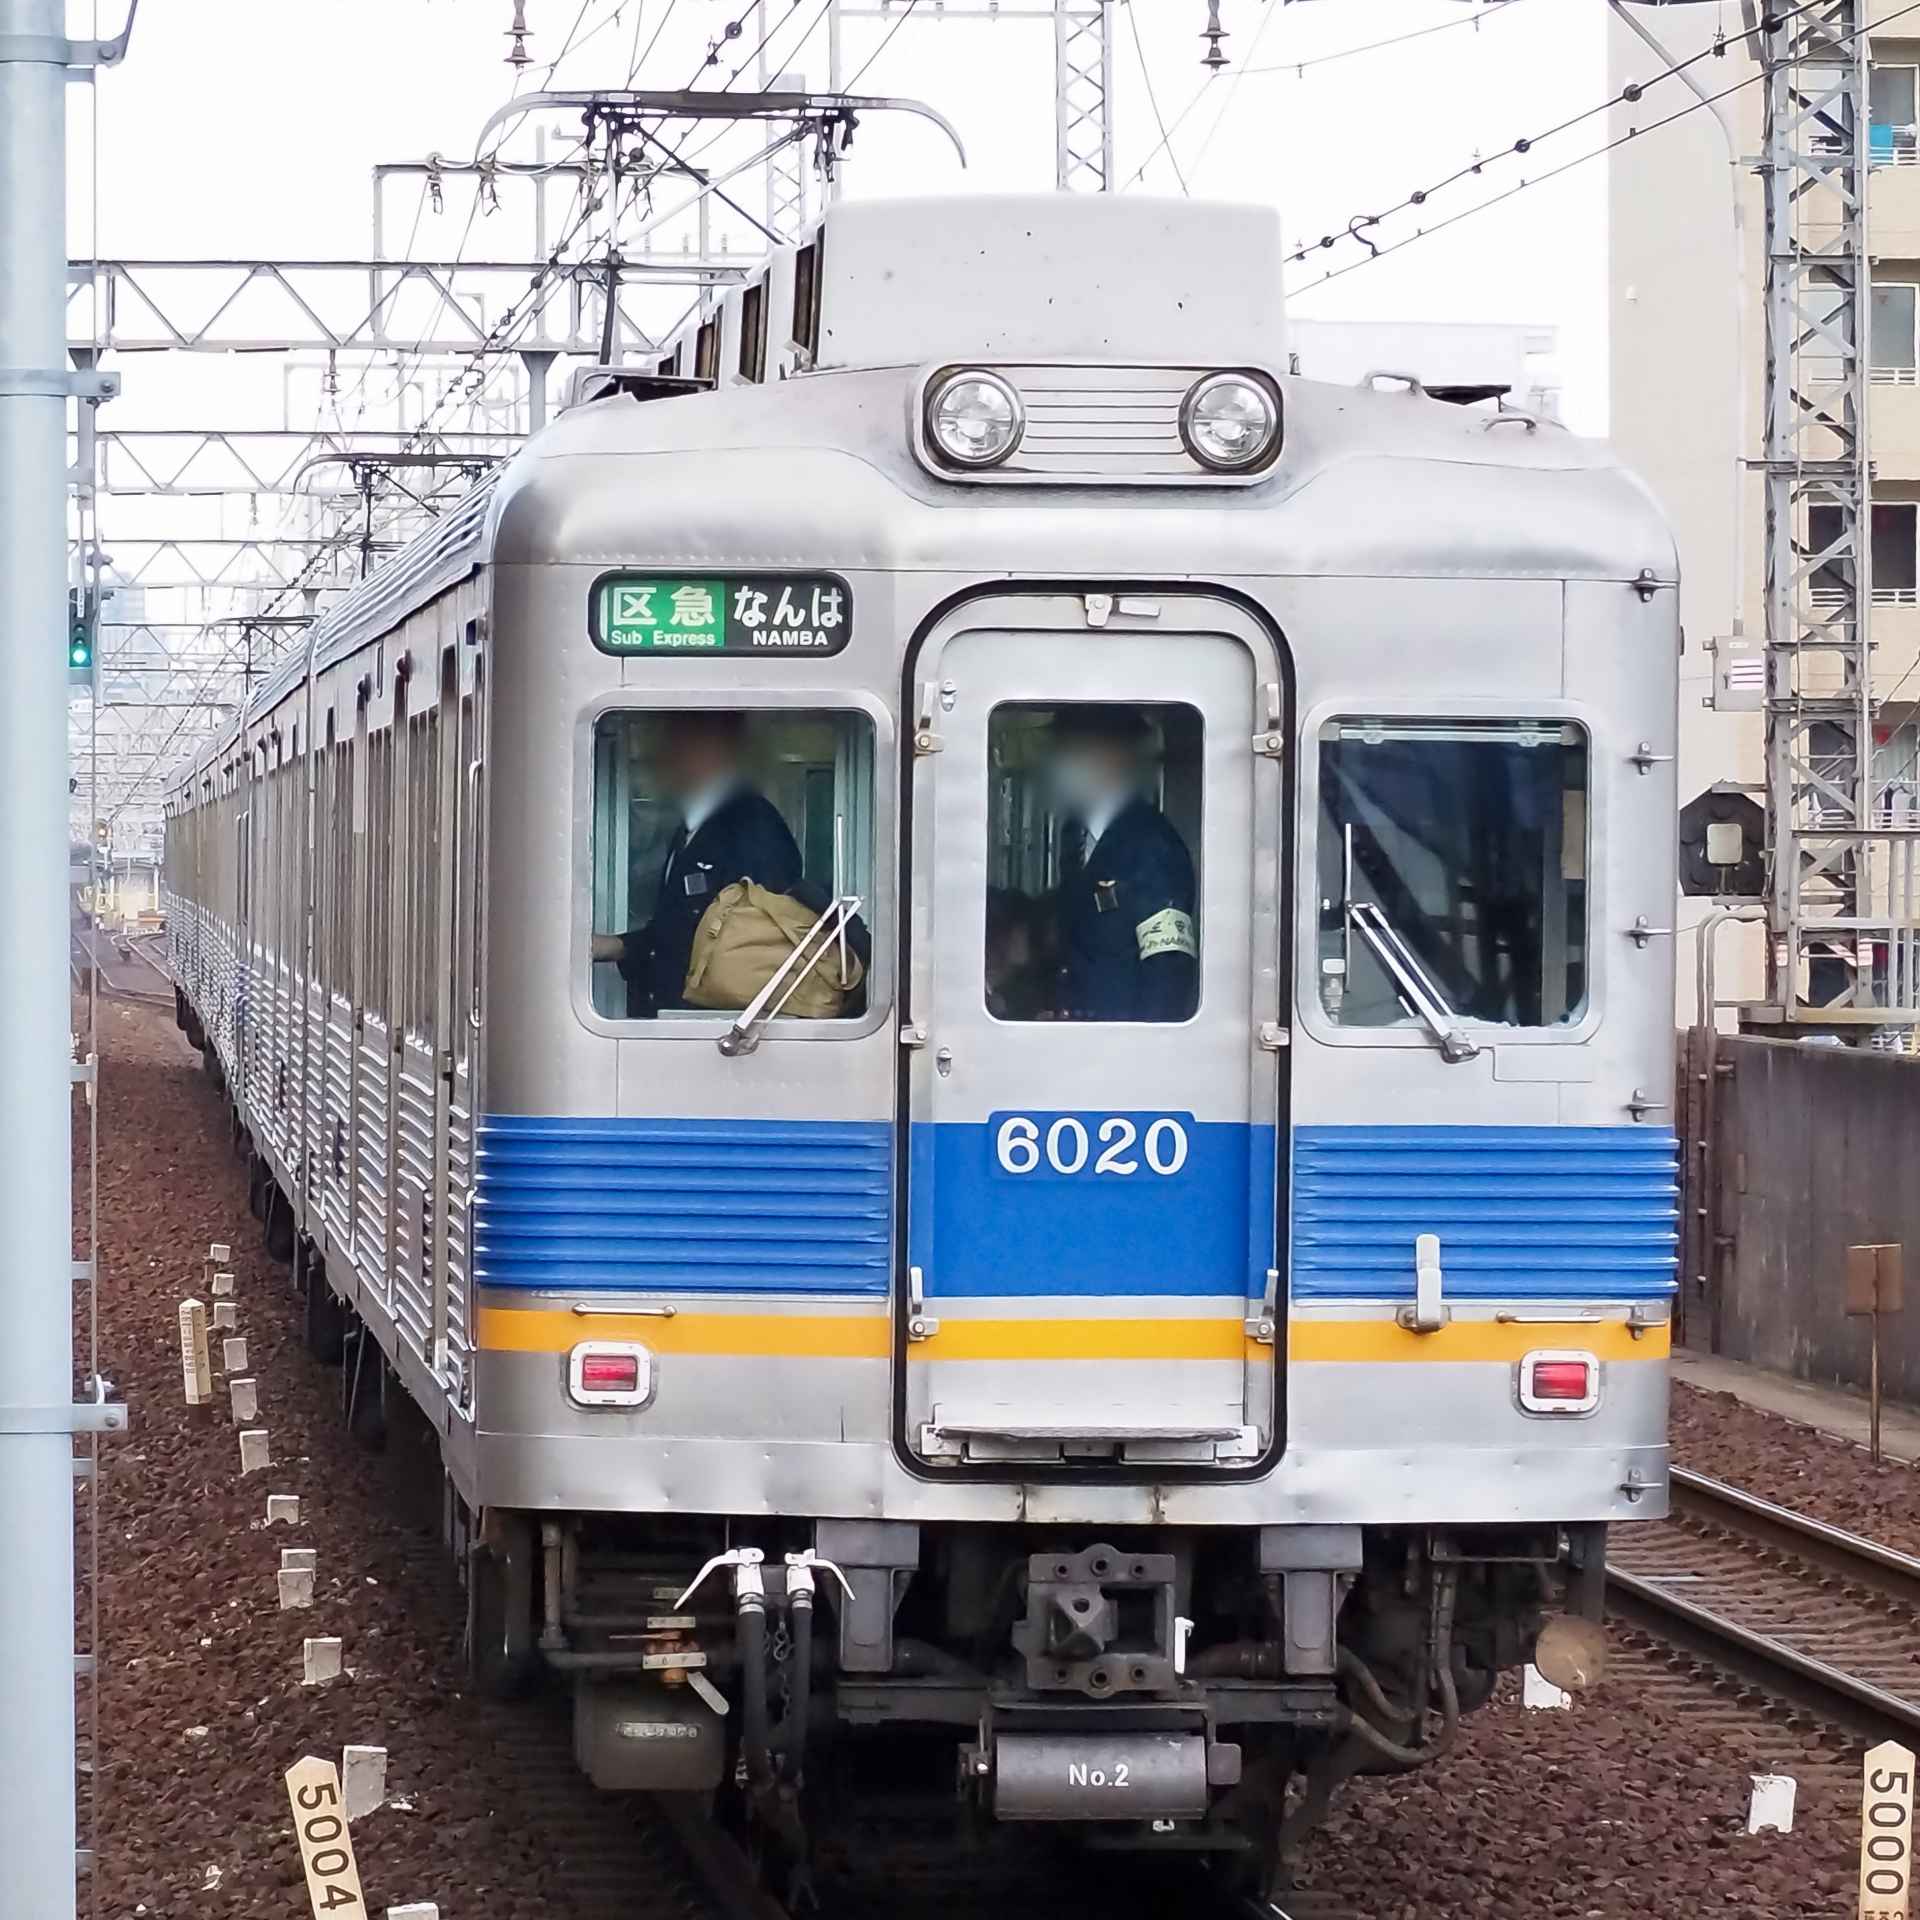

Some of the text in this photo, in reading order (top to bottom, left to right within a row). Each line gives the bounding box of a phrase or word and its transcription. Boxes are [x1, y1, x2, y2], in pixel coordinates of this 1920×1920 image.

[612, 586, 716, 626] 区急
[611, 630, 715, 647] Sub Express
[752, 630, 828, 646] NAMBA
[997, 1116, 1188, 1176] 6020
[1069, 1763, 1130, 1787] No.2
[297, 1782, 358, 1911] 5004
[1865, 1768, 1908, 1894] 5000
